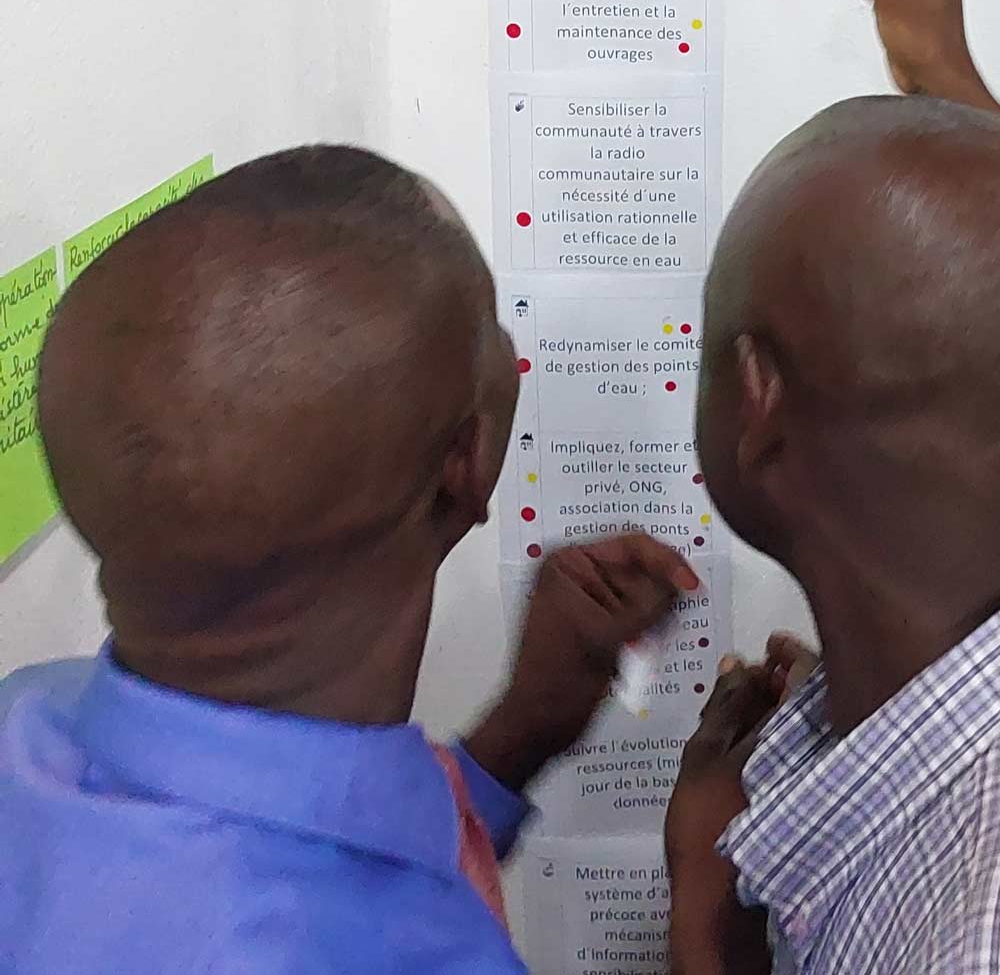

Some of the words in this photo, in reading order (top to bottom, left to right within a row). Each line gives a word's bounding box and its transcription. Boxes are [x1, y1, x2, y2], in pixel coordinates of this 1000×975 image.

[645, 7, 658, 17] et
[664, 5, 675, 18] la
[558, 25, 652, 39] maintenance
[658, 27, 681, 40] des
[588, 50, 652, 63] ouvrages
[568, 103, 649, 116] Sensibiliser
[655, 103, 666, 115] la
[536, 125, 631, 137] communauté
[637, 124, 644, 137] à
[650, 126, 701, 137] travers
[591, 146, 602, 159] la
[608, 147, 644, 159] radio
[539, 169, 654, 180] communautaire
[660, 171, 682, 180] sur
[687, 167, 698, 180] la
[563, 188, 628, 202] nécessité
[542, 209, 612, 223] utilisation
[618, 210, 696, 224] rationnelle
[564, 233, 577, 243] et
[583, 231, 636, 245] efficace
[642, 233, 659, 245] de
[665, 233, 676, 245] la
[560, 255, 627, 266] ressource
[633, 257, 649, 266] en
[655, 257, 680, 266] eau
[540, 339, 632, 355] Redynamiser
[637, 339, 648, 351] le
[653, 337, 703, 351] comité
[546, 360, 562, 372] de
[568, 361, 619, 376] gestion
[625, 360, 648, 372] des
[653, 359, 699, 374] points
[551, 440, 625, 456] Impliquez,
[630, 440, 679, 452] former
[562, 461, 613, 473] outiller
[619, 460, 629, 472] le
[635, 463, 687, 473] secteur
[585, 480, 624, 496] privé,
[630, 481, 666, 495] ONG,
[560, 502, 639, 514] association
[644, 501, 676, 514] dans
[682, 502, 692, 514] la
[565, 522, 616, 537] gestion
[651, 524, 689, 535] ponts
[577, 760, 653, 775] ressources
[580, 780, 610, 796] jour
[615, 777, 632, 790] de
[636, 777, 648, 788] la
[576, 867, 625, 880] Mettre
[629, 868, 647, 879] en
[584, 888, 643, 903] système
[590, 908, 646, 922] précoce
